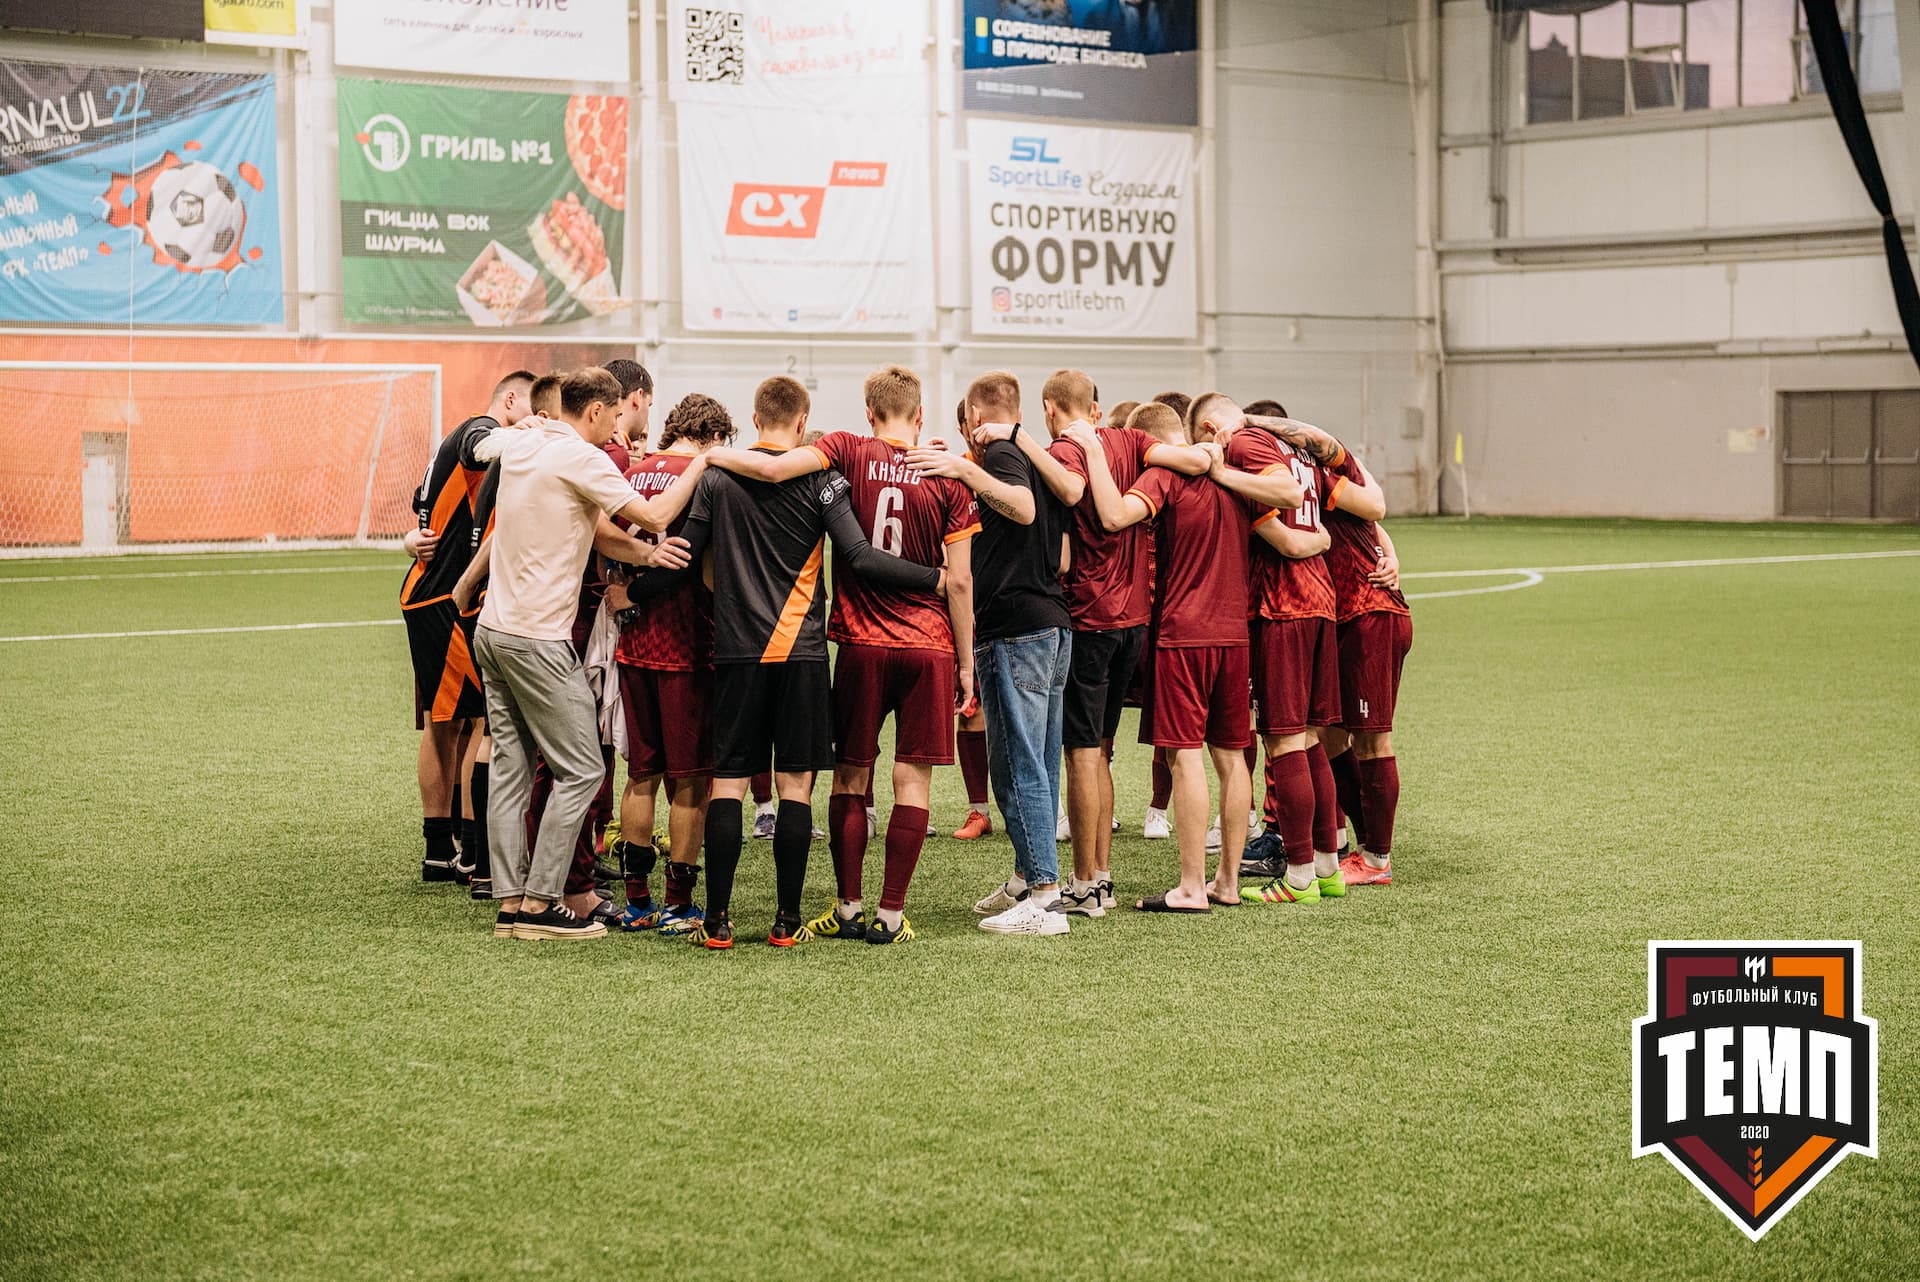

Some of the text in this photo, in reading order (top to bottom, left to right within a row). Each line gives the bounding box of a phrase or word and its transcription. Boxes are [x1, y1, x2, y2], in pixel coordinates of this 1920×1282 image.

[991, 18, 1112, 48] СОРЕВНОВАНИЕ
[1006, 40, 1079, 65] ПРИРОДЕ
[1080, 47, 1148, 70] БИЗНЕСА
[420, 133, 555, 166] ГРИЛЬ №1
[1009, 136, 1061, 164] SL
[989, 165, 1083, 189] SportLife
[364, 208, 440, 232] ПИЦЦА
[990, 202, 1177, 235] СПОРТИВНУЮ
[364, 233, 446, 254] ШАУРМА
[991, 235, 1176, 288] ФОРМУ
[1014, 289, 1126, 313] sportlifebrn
[872, 486, 904, 558] 6
[1359, 698, 1369, 719] 4
